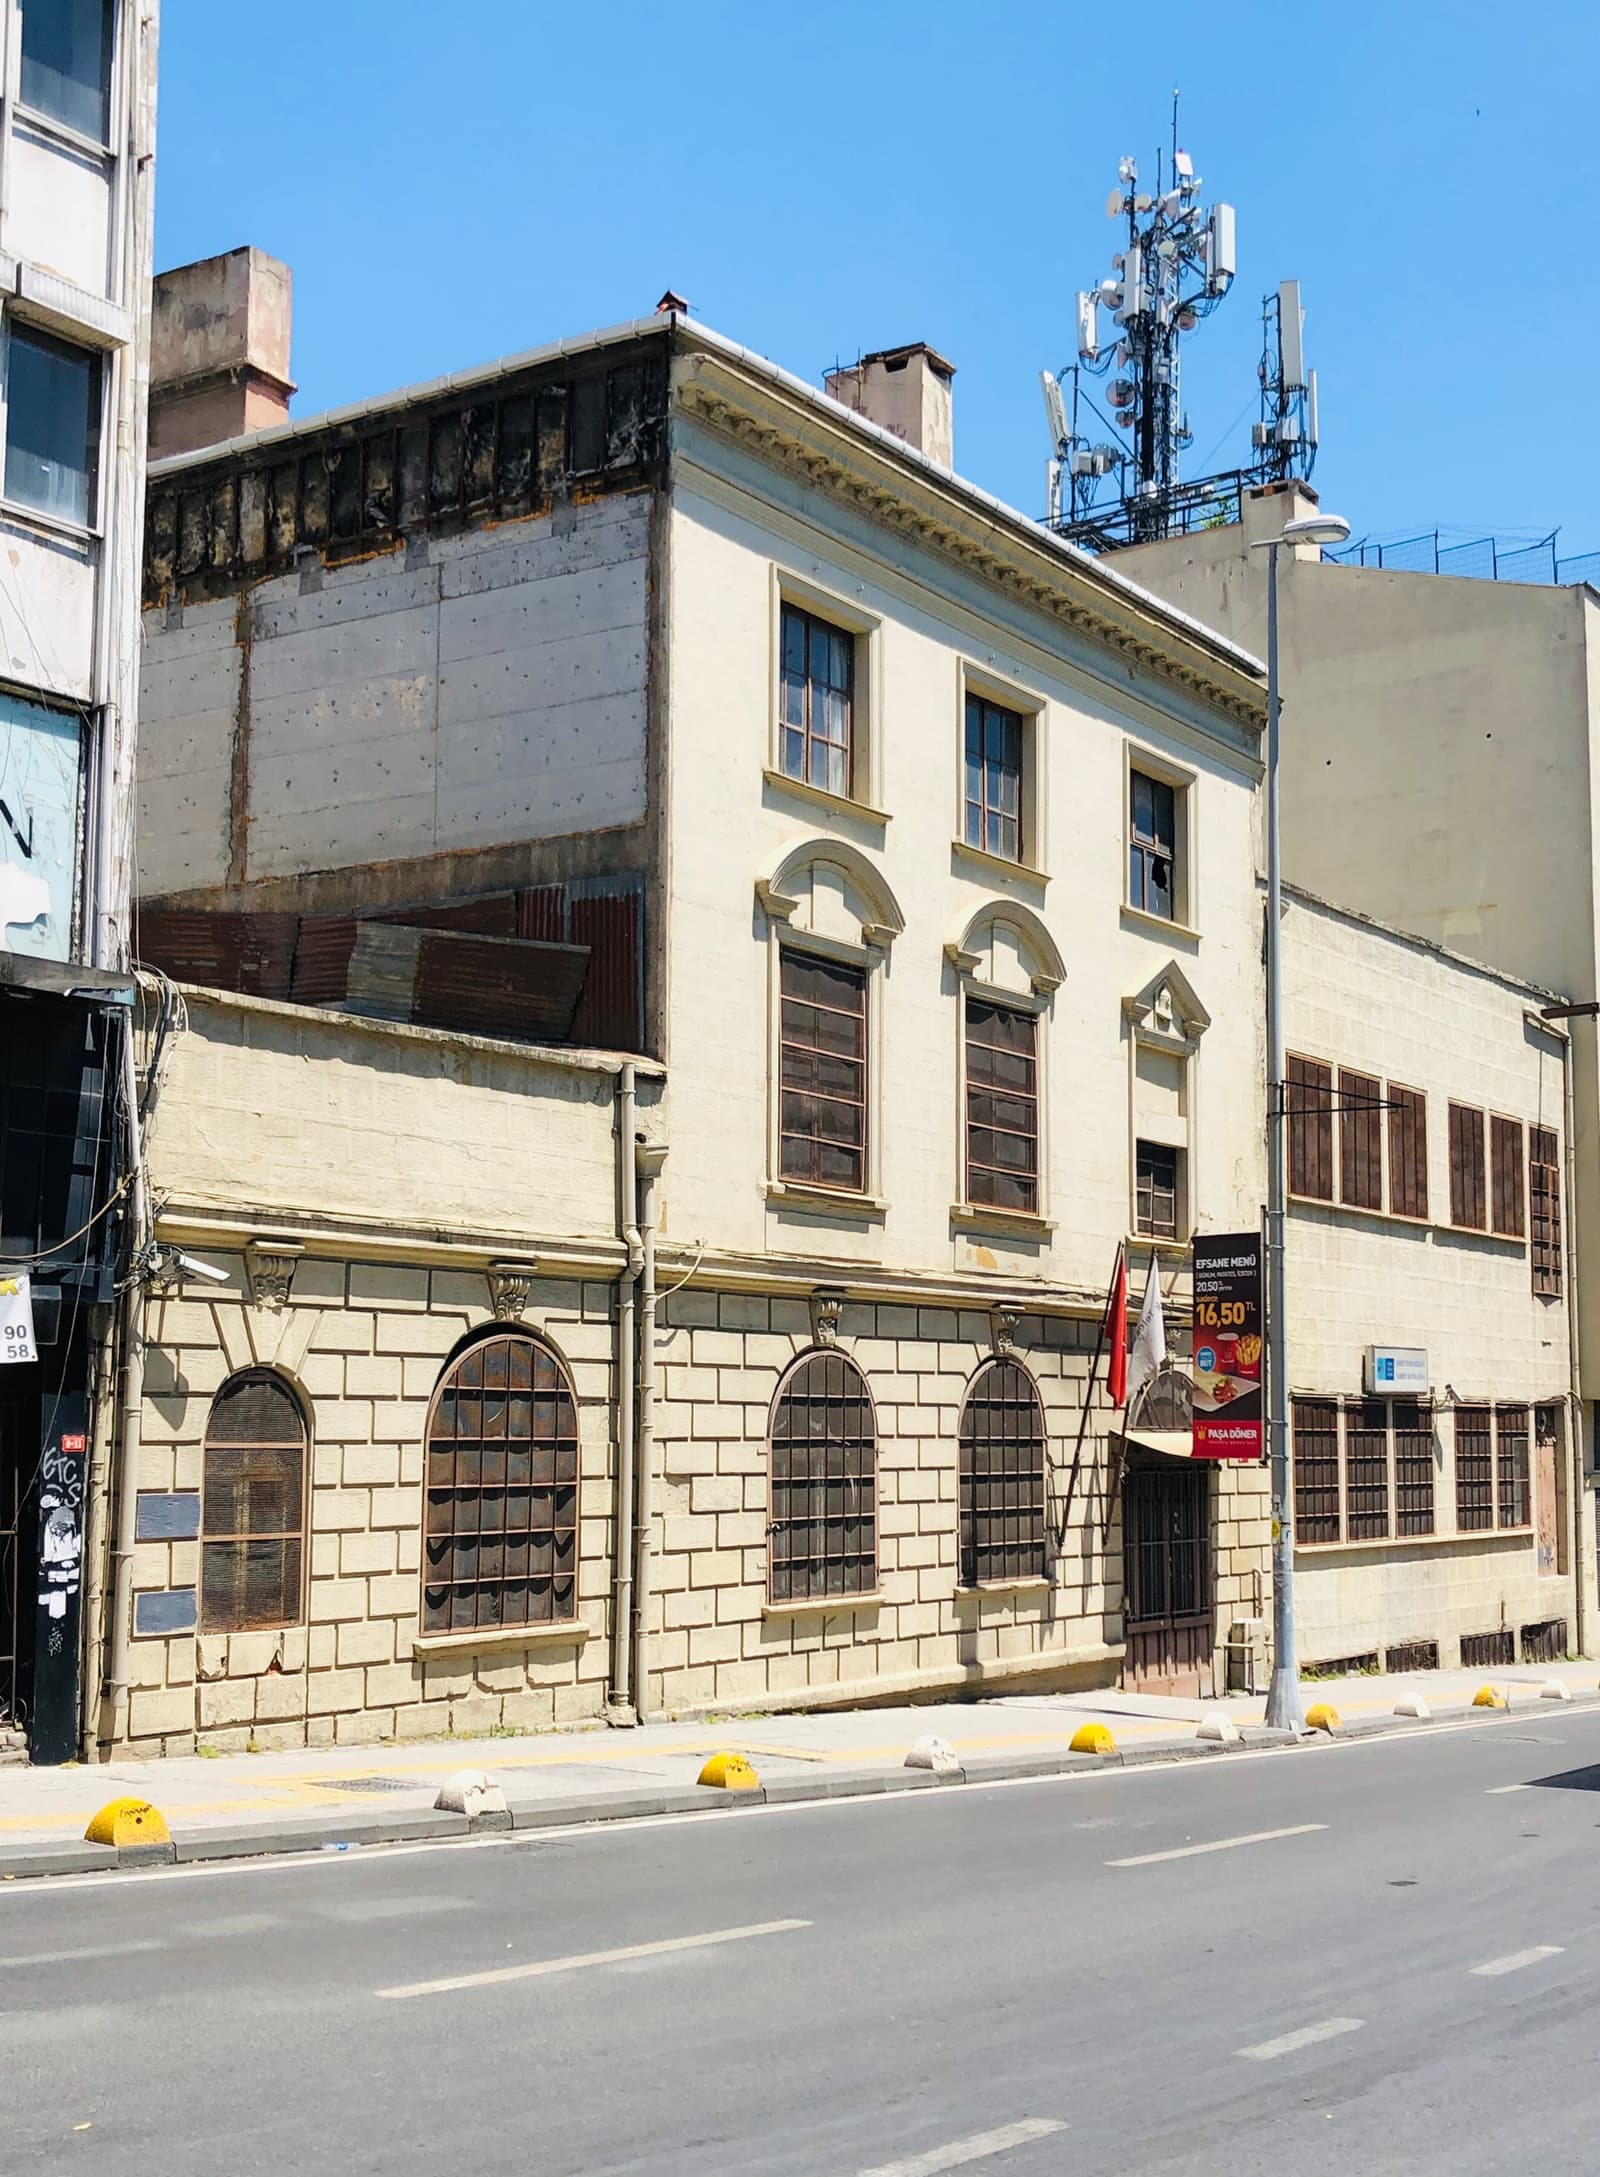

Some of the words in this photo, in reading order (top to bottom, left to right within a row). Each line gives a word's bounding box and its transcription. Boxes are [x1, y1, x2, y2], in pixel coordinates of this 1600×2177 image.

[1196, 1257, 1229, 1269] EFSANE
[1231, 1254, 1256, 1267] MENÜ
[1196, 1302, 1245, 1328] 16,50
[1246, 1302, 1256, 1311] TL
[4, 1324, 27, 1340] 90
[7, 1344, 29, 1359] 58
[1208, 1429, 1229, 1441] PAŞA
[1229, 1426, 1257, 1439] DÖNER
